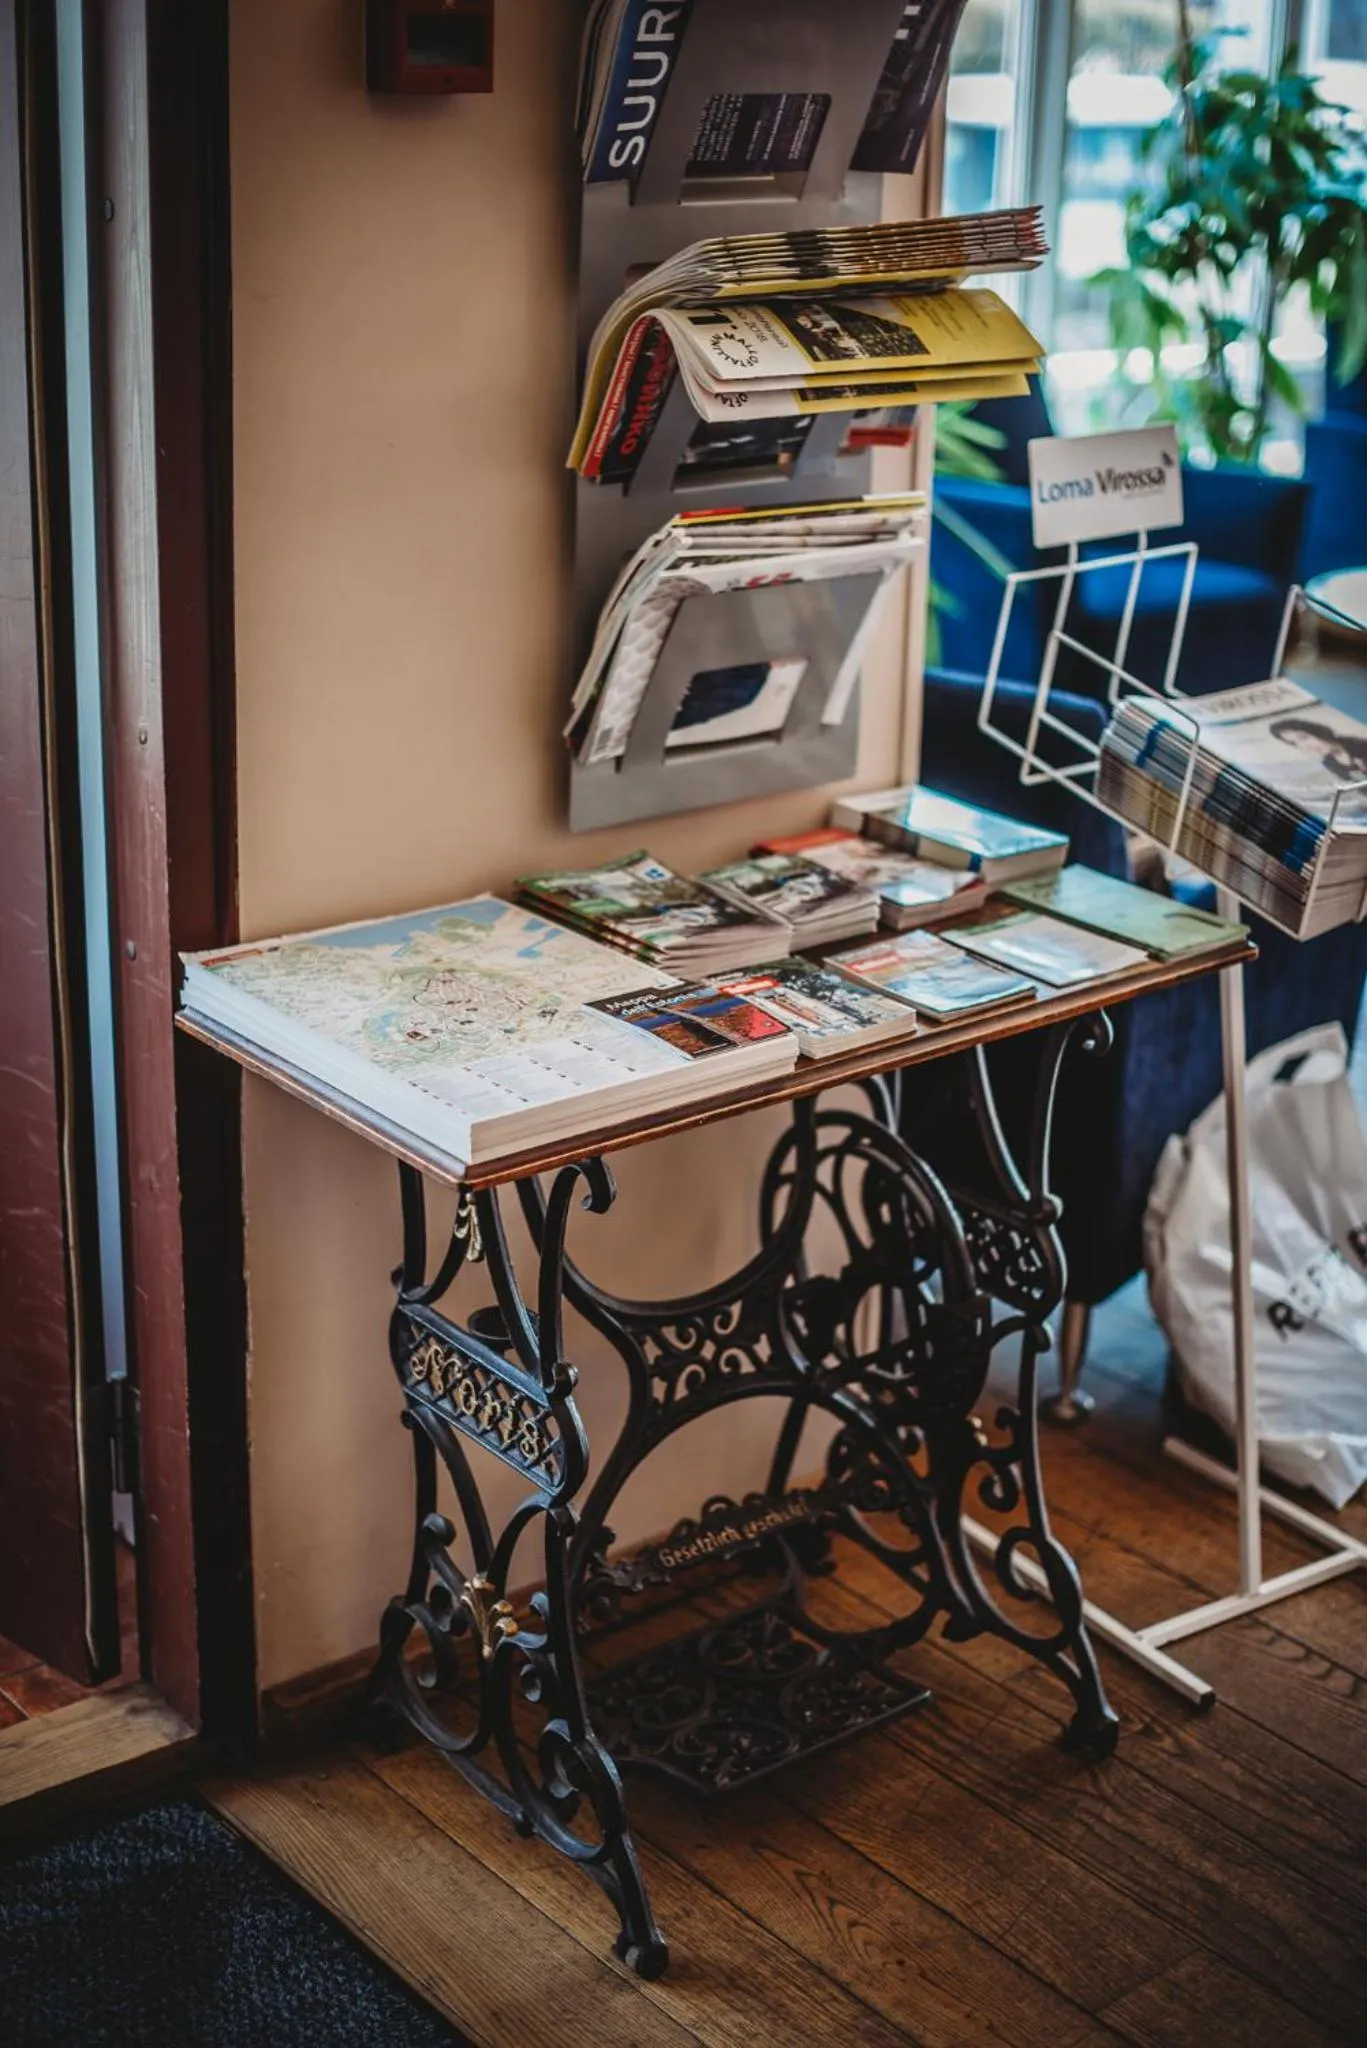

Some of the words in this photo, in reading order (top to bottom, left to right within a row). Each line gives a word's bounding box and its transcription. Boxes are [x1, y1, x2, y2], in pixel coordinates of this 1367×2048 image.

[608, 0, 682, 170] SUUR
[1038, 476, 1095, 505] Loma
[1095, 466, 1167, 496] Virossa
